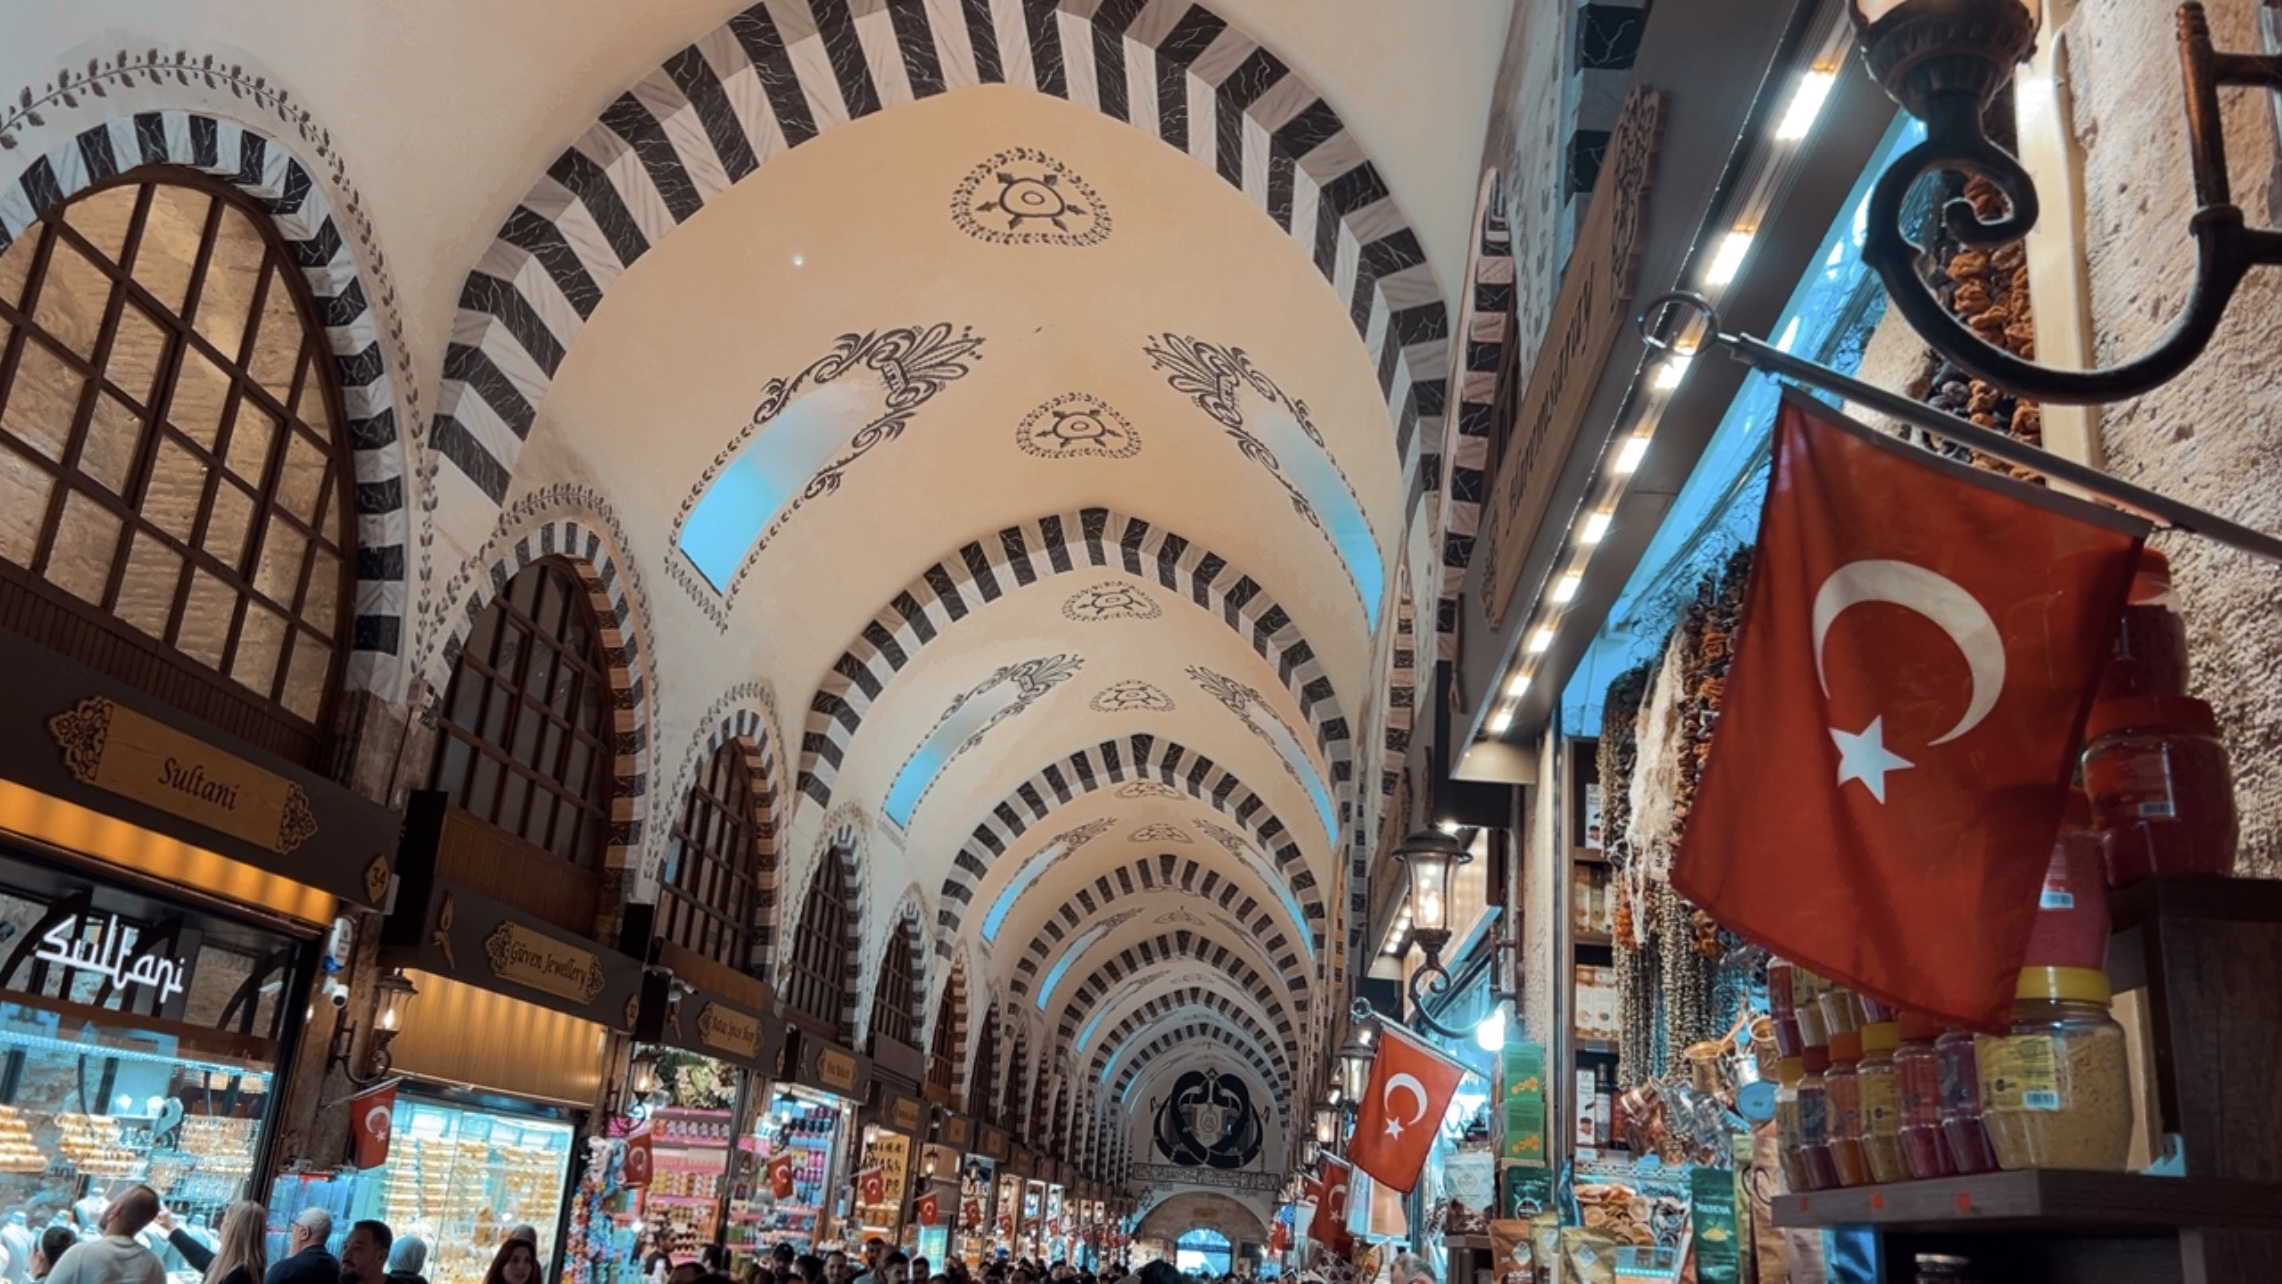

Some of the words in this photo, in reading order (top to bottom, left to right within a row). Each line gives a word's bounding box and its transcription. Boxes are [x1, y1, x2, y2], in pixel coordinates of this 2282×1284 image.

[158, 756, 240, 811] Sultani
[370, 866, 387, 890] 34
[510, 941, 543, 968] Güven
[542, 953, 588, 990] Jewellery
